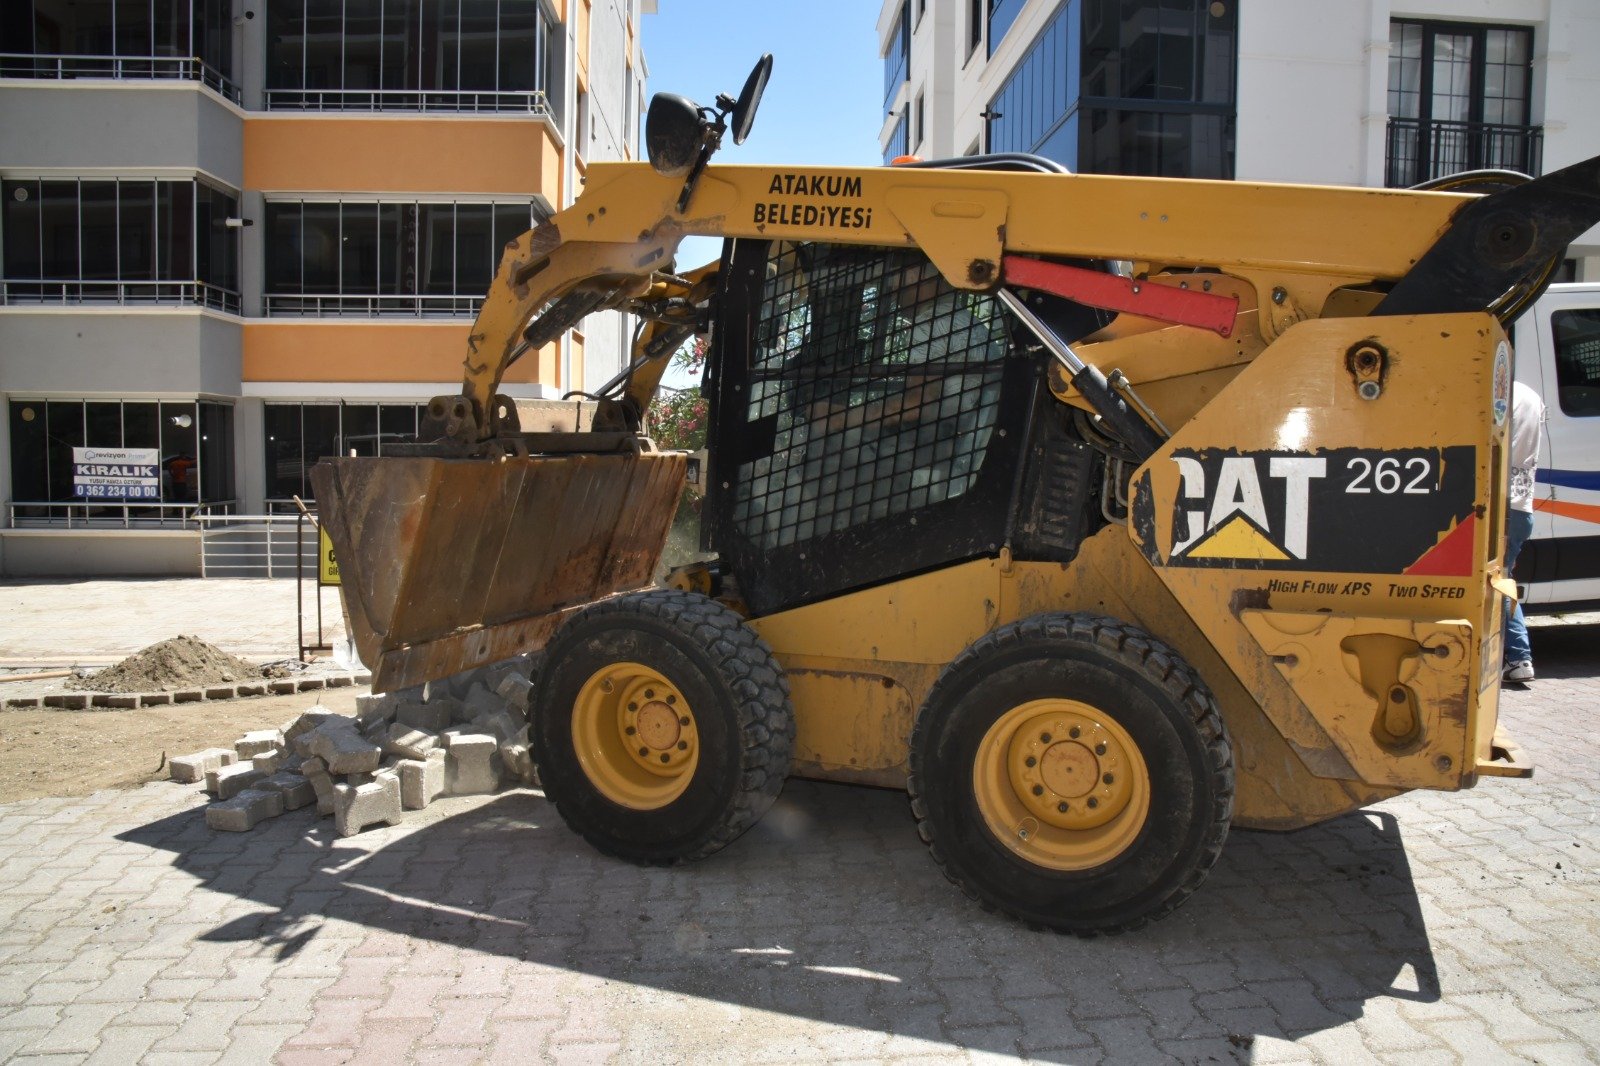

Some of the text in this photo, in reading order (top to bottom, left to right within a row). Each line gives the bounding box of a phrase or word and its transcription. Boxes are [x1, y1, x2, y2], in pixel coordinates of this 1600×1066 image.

[768, 174, 862, 198] ATAKUM
[96, 451, 126, 459] revizyon
[1345, 457, 1431, 494] 262
[77, 485, 157, 497] 0 362 234 00 00
[1341, 581, 1372, 596] XPS
